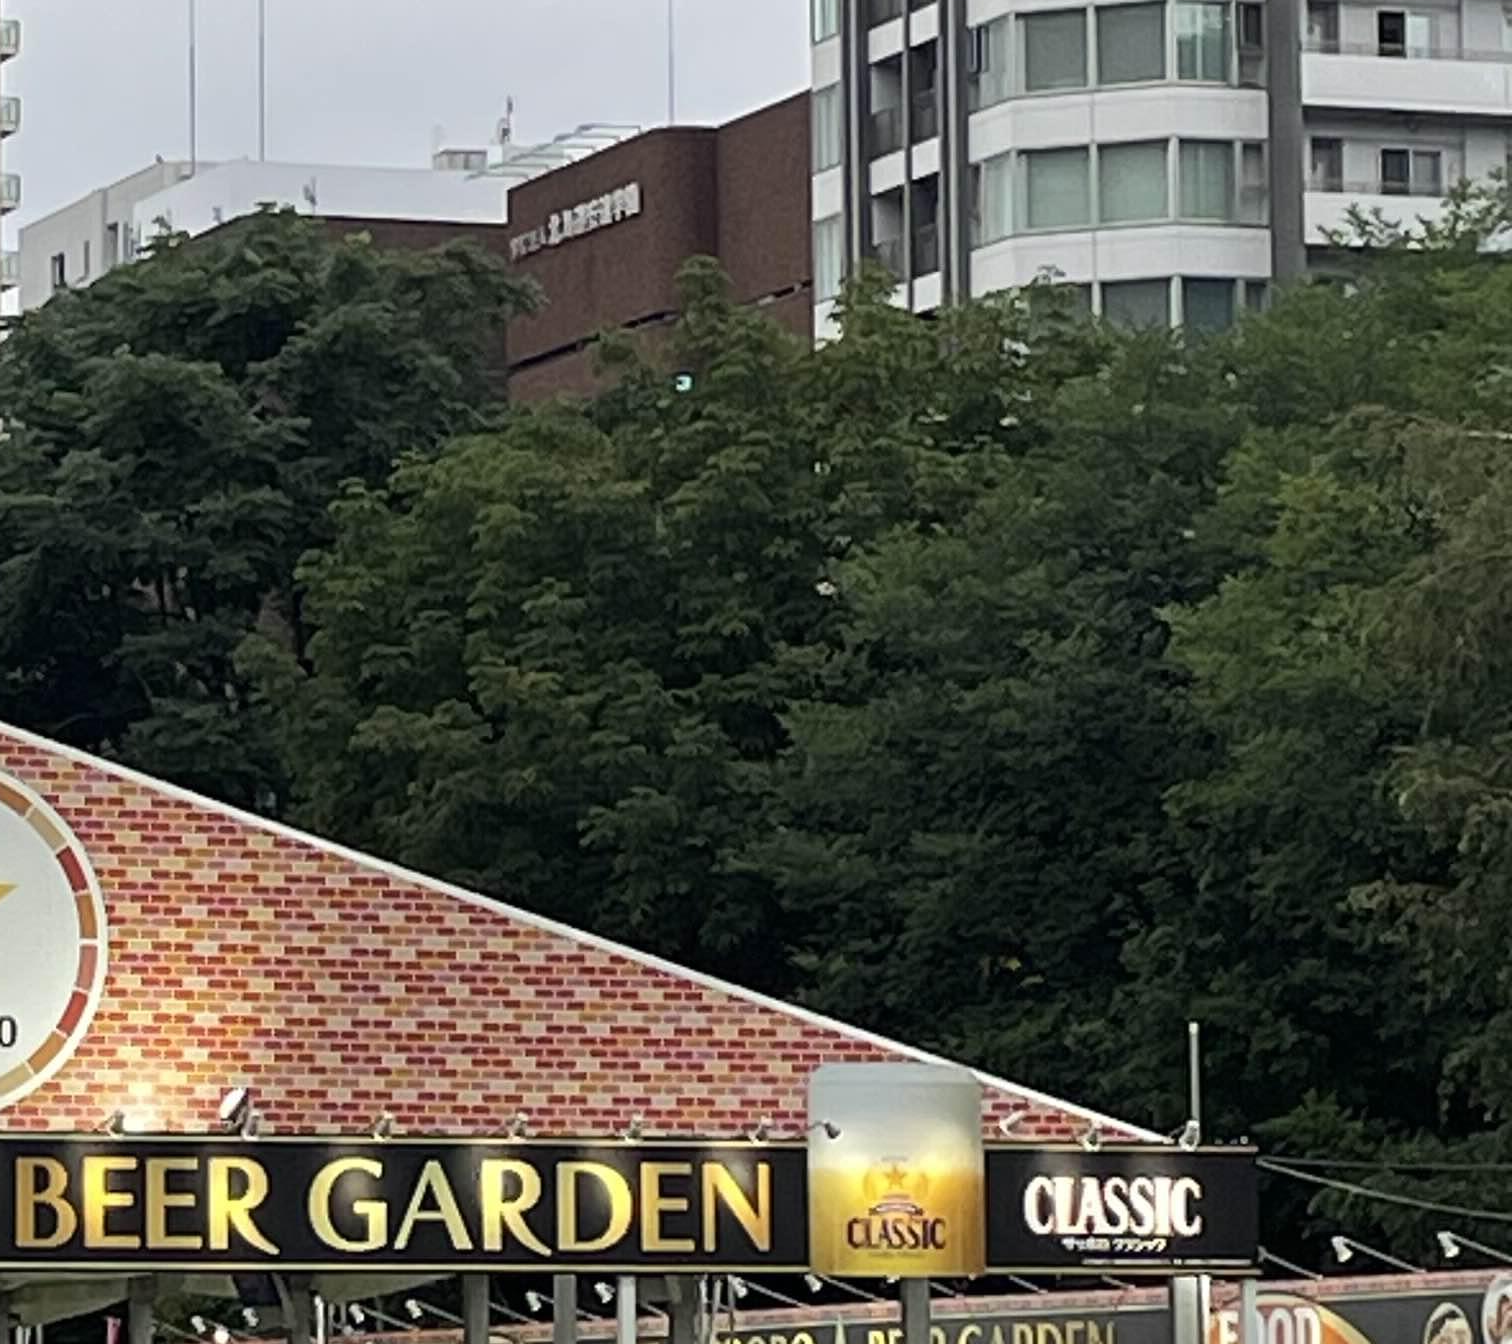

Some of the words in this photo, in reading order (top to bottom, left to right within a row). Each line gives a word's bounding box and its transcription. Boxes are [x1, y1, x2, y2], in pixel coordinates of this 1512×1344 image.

[14, 1155, 280, 1256] BEER
[307, 1157, 771, 1256] GARDEN
[847, 1217, 947, 1250] CLASSIC
[1023, 1175, 1204, 1237] CLASSIC
